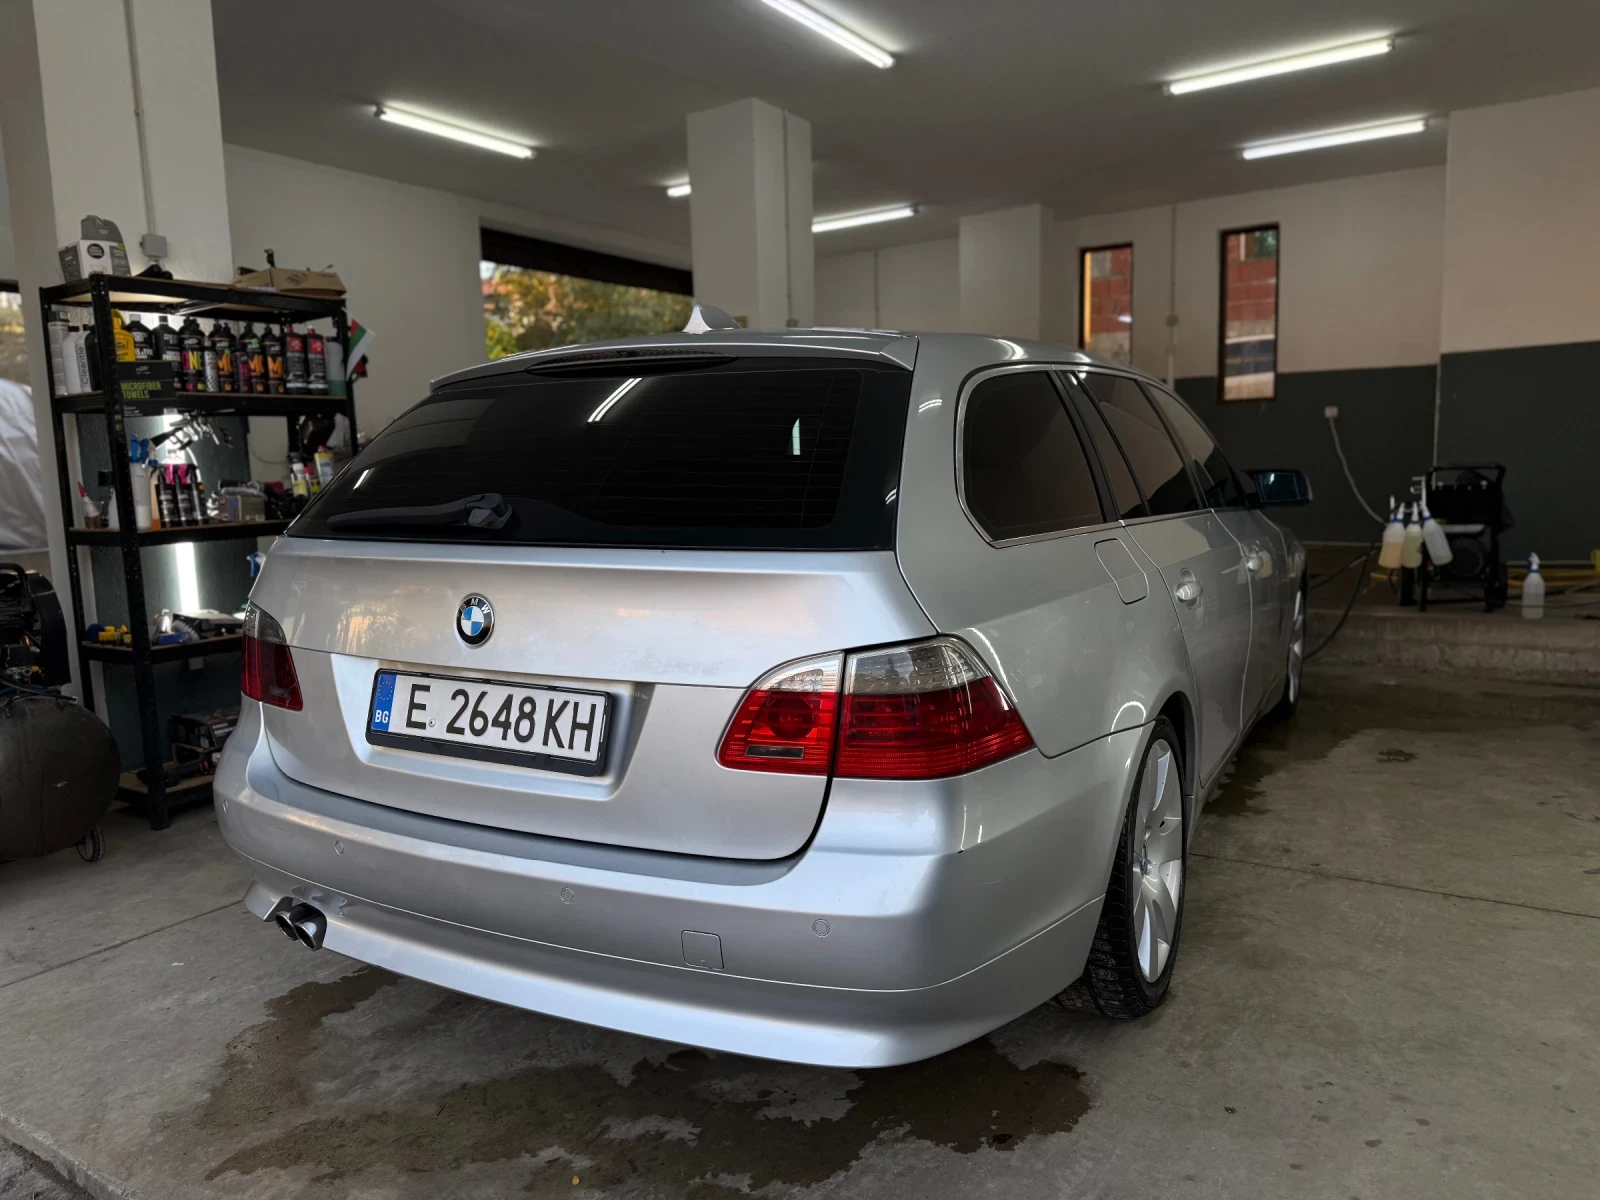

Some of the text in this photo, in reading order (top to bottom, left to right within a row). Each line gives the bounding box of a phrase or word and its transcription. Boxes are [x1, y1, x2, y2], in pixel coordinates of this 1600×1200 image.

[78, 347, 88, 384] Cleantle
[181, 350, 204, 370] ONE
[120, 381, 162, 391] MICROFIBER
[122, 390, 150, 400] TOWELS
[459, 597, 491, 614] BMW
[374, 709, 390, 724] BG
[406, 683, 597, 752] E 2648 KH
